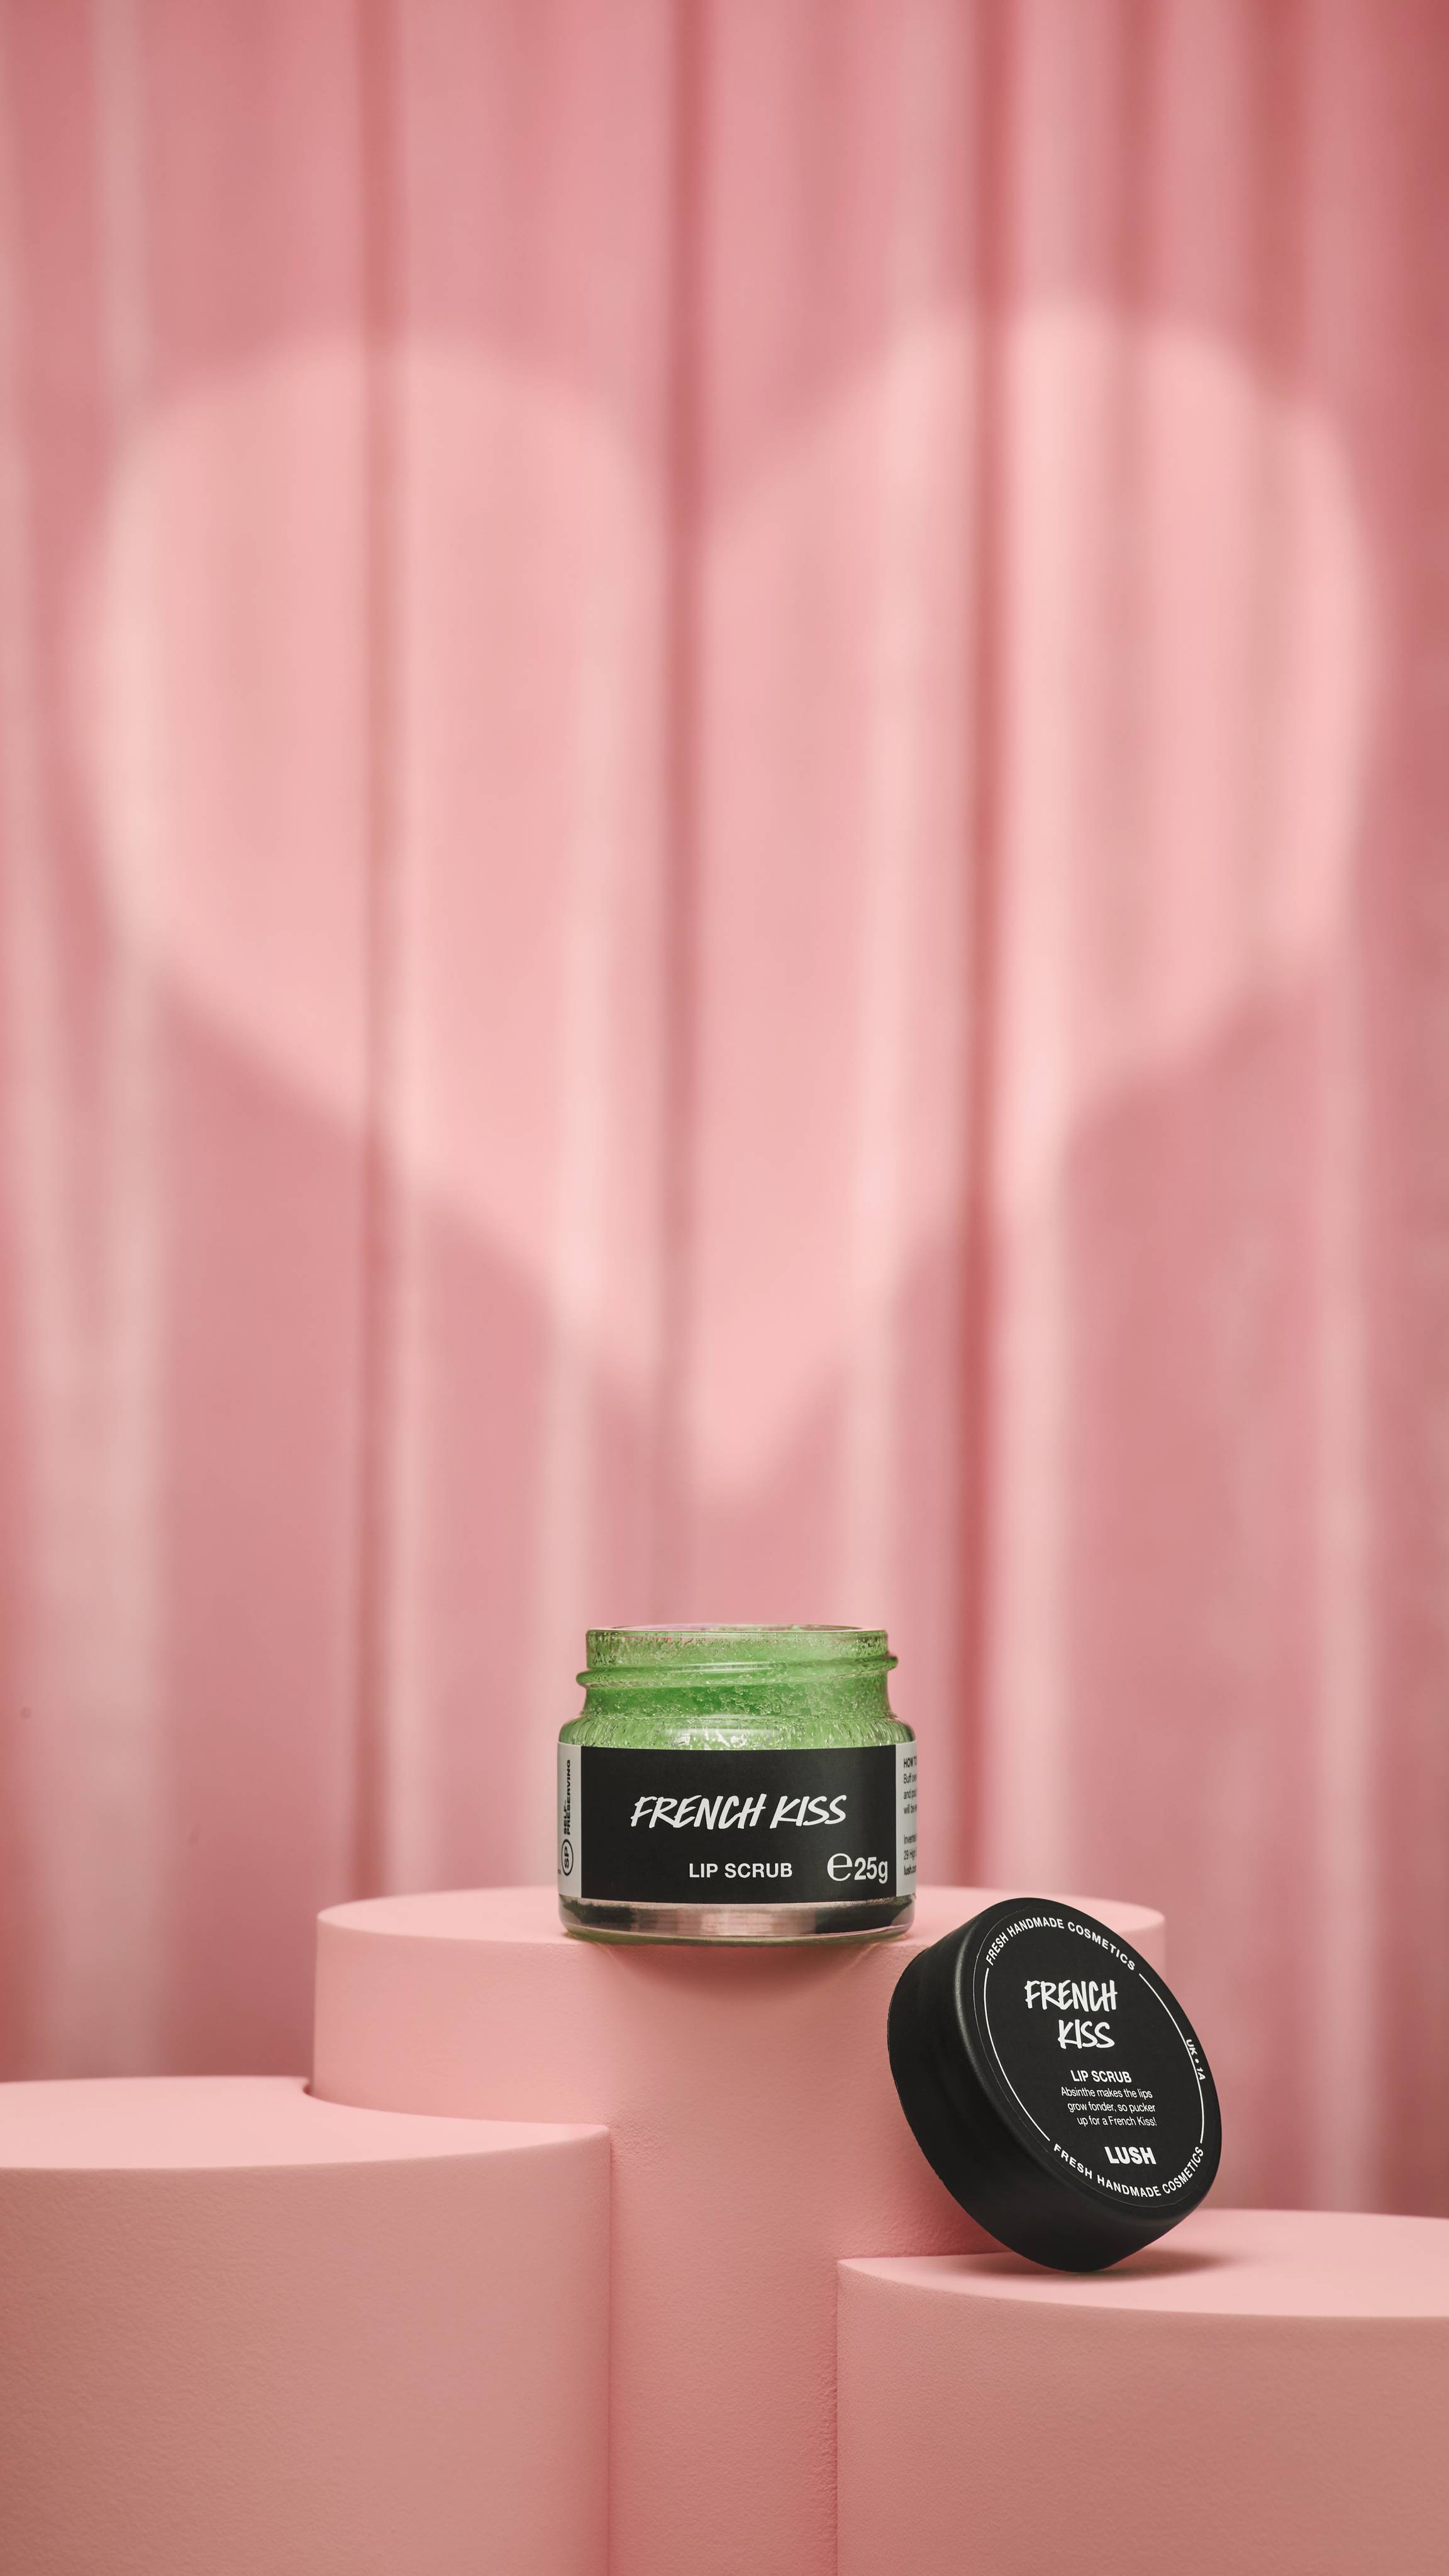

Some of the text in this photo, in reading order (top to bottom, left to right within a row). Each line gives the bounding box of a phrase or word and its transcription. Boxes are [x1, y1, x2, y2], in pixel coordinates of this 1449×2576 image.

[903, 1789, 911, 1799] and
[630, 1794, 847, 1830] FRENCH KISS
[564, 1846, 569, 1868] SP
[904, 1850, 909, 1860] 29
[689, 1863, 793, 1879] LIP SCRUB
[985, 1916, 1135, 1971] FRESH HANDMADE COSMETICS
[1024, 1979, 1118, 2012] FRENCH
[1057, 2019, 1116, 2050] KISS
[1185, 2039, 1206, 2080] UK 1A
[1070, 2070, 1132, 2083] LIP SCRUB
[1061, 2086, 1153, 2101] Absinthe makes the lips
[1067, 2101, 1156, 2114] grow fonder, so pucker
[1077, 2117, 1089, 2127] up
[1088, 2115, 1100, 2126] for
[1108, 2116, 1137, 2126] French
[1136, 2116, 1157, 2126] Kiss!
[1104, 2146, 1157, 2165] LUSH
[1053, 2143, 1204, 2198] FRESH HANDMADE COSMETICS
